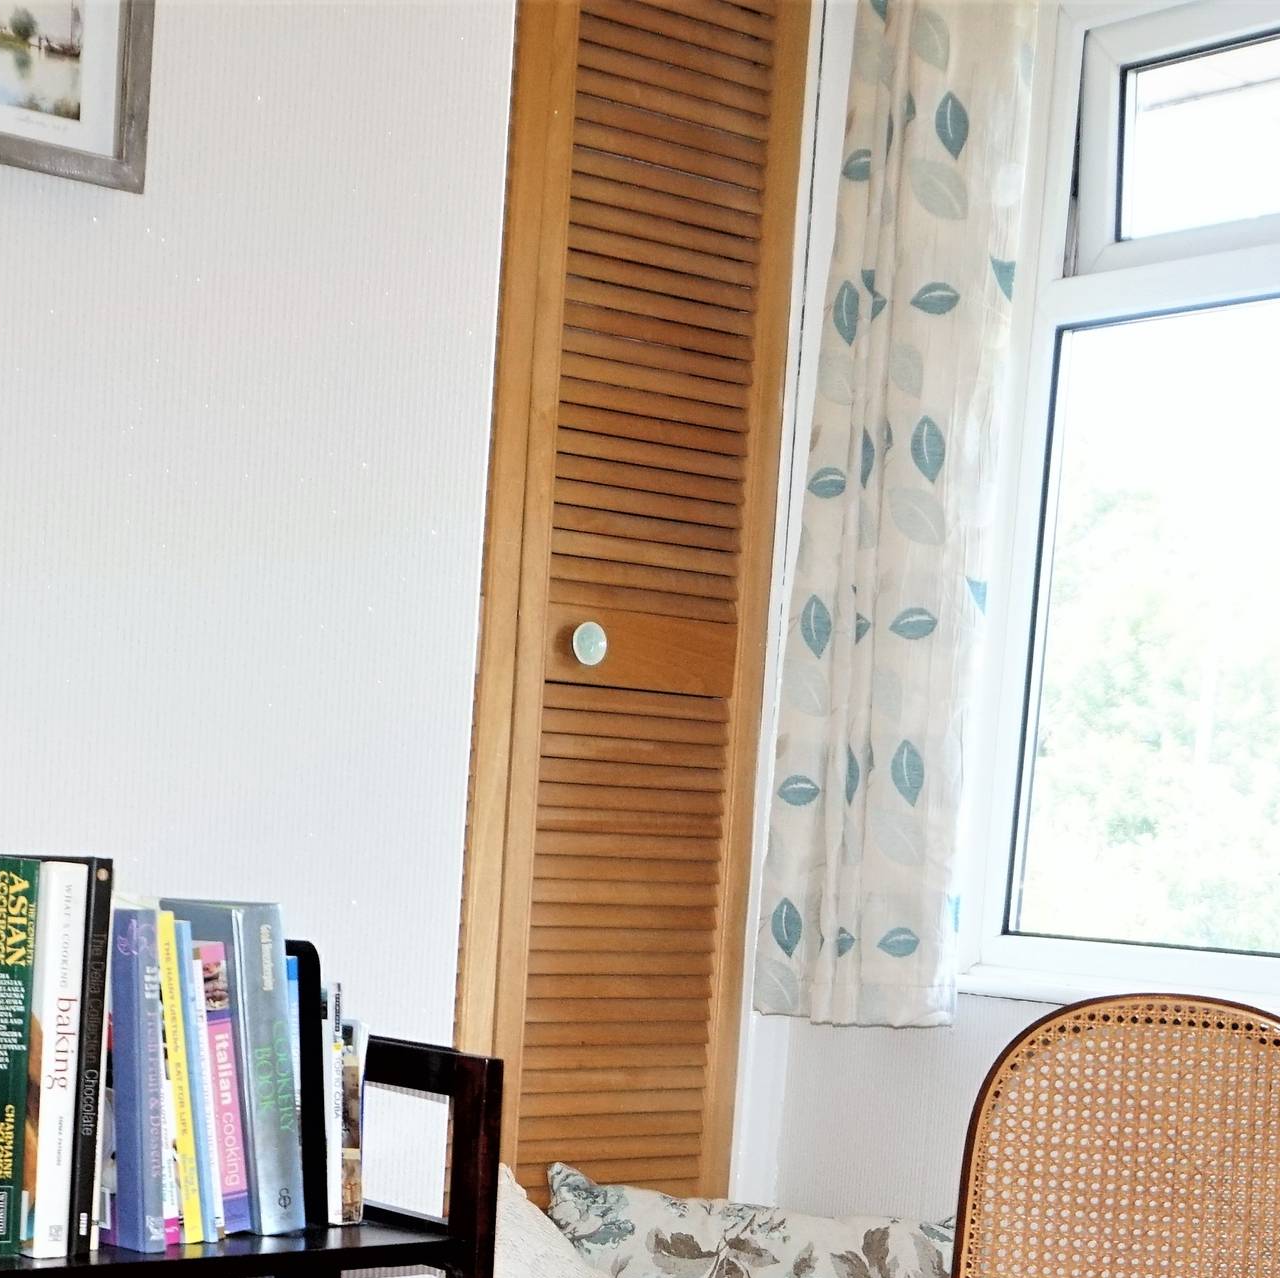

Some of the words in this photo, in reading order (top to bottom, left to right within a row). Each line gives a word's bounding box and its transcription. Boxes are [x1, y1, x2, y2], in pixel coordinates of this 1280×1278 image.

[6, 871, 30, 967] ASIAN
[91, 933, 106, 955] The
[89, 961, 105, 994] Delia
[85, 998, 102, 1066] Collection
[81, 1069, 99, 1137] Chocolate
[213, 1033, 234, 1105] italian
[253, 1046, 275, 1116] BOOK
[271, 1019, 295, 1133] COOKERY
[3, 1104, 16, 1180] CHARMAINE
[218, 1111, 241, 1187] cooking
